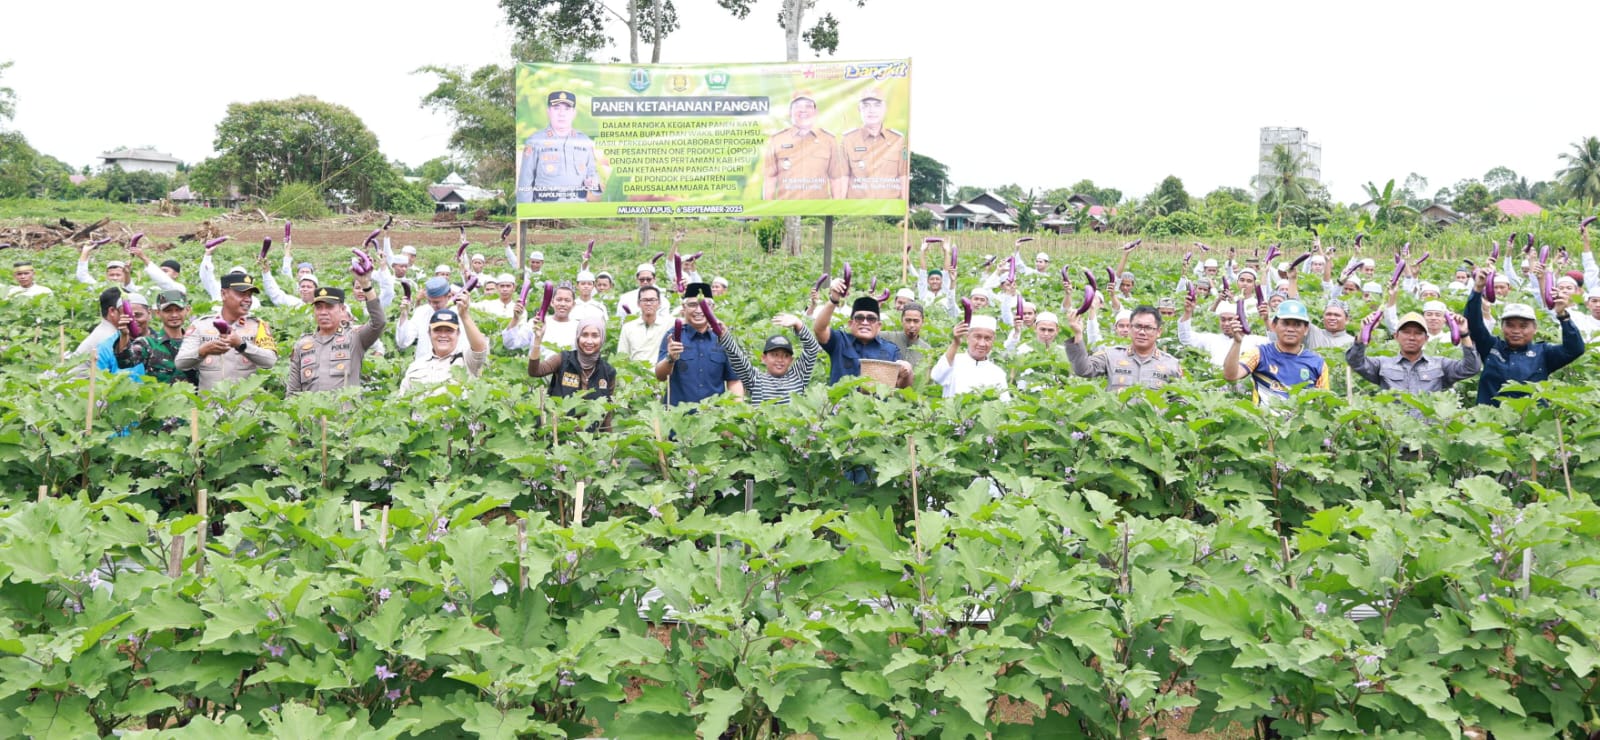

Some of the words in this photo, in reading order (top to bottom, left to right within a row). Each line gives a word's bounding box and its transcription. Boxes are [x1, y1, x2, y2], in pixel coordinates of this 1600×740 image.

[592, 101, 634, 112] PANEN
[636, 101, 712, 112] KETAHANAN
[714, 101, 768, 112] PANGAN
[602, 121, 631, 129] DALAM
[631, 121, 666, 129] RANGKA
[667, 121, 708, 129] KEGIATAN
[639, 130, 668, 138] BUPATI
[671, 138, 722, 146] KOLABORASI
[723, 138, 764, 146] PROGRAM
[687, 147, 725, 155] PRODUCT
[727, 146, 757, 155] (OPOP)
[609, 157, 643, 165] DENGAN
[671, 156, 715, 164] PERTANIAN
[686, 165, 720, 173] PANGAN
[624, 184, 679, 192] DARUSSALAM
[711, 183, 737, 191] TAPUS
[617, 206, 645, 214] MUARA
[646, 206, 674, 215] TAPUS,
[682, 205, 724, 213] SEPTEMBER
[723, 205, 743, 213] 2025
